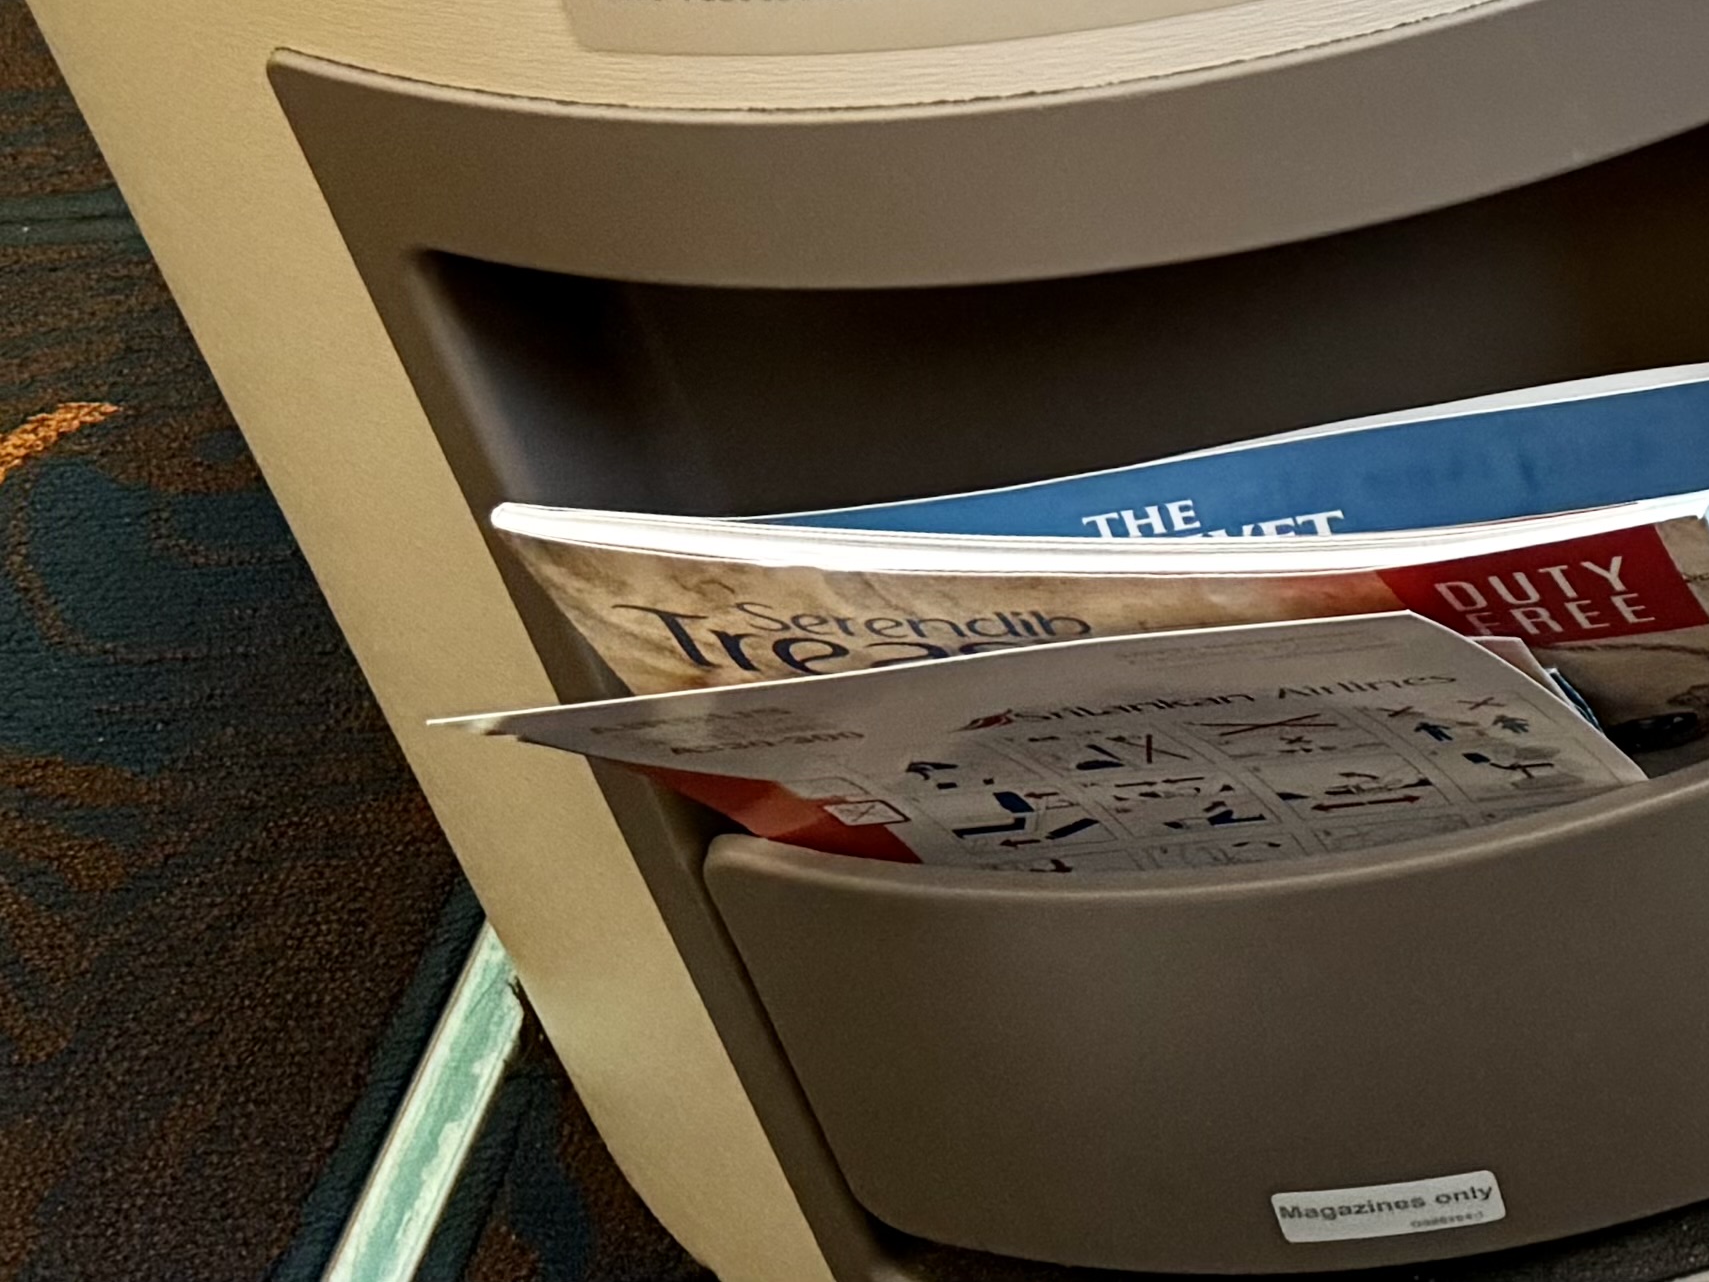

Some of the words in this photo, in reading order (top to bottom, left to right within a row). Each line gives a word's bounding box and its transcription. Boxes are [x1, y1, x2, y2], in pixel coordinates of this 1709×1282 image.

[1082, 499, 1201, 538] THE
[1434, 555, 1628, 612] DUTY
[736, 601, 1093, 639] Serendib
[1465, 592, 1656, 636] FREE
[1278, 1196, 1427, 1221] Magazines
[1435, 1185, 1493, 1202] only
